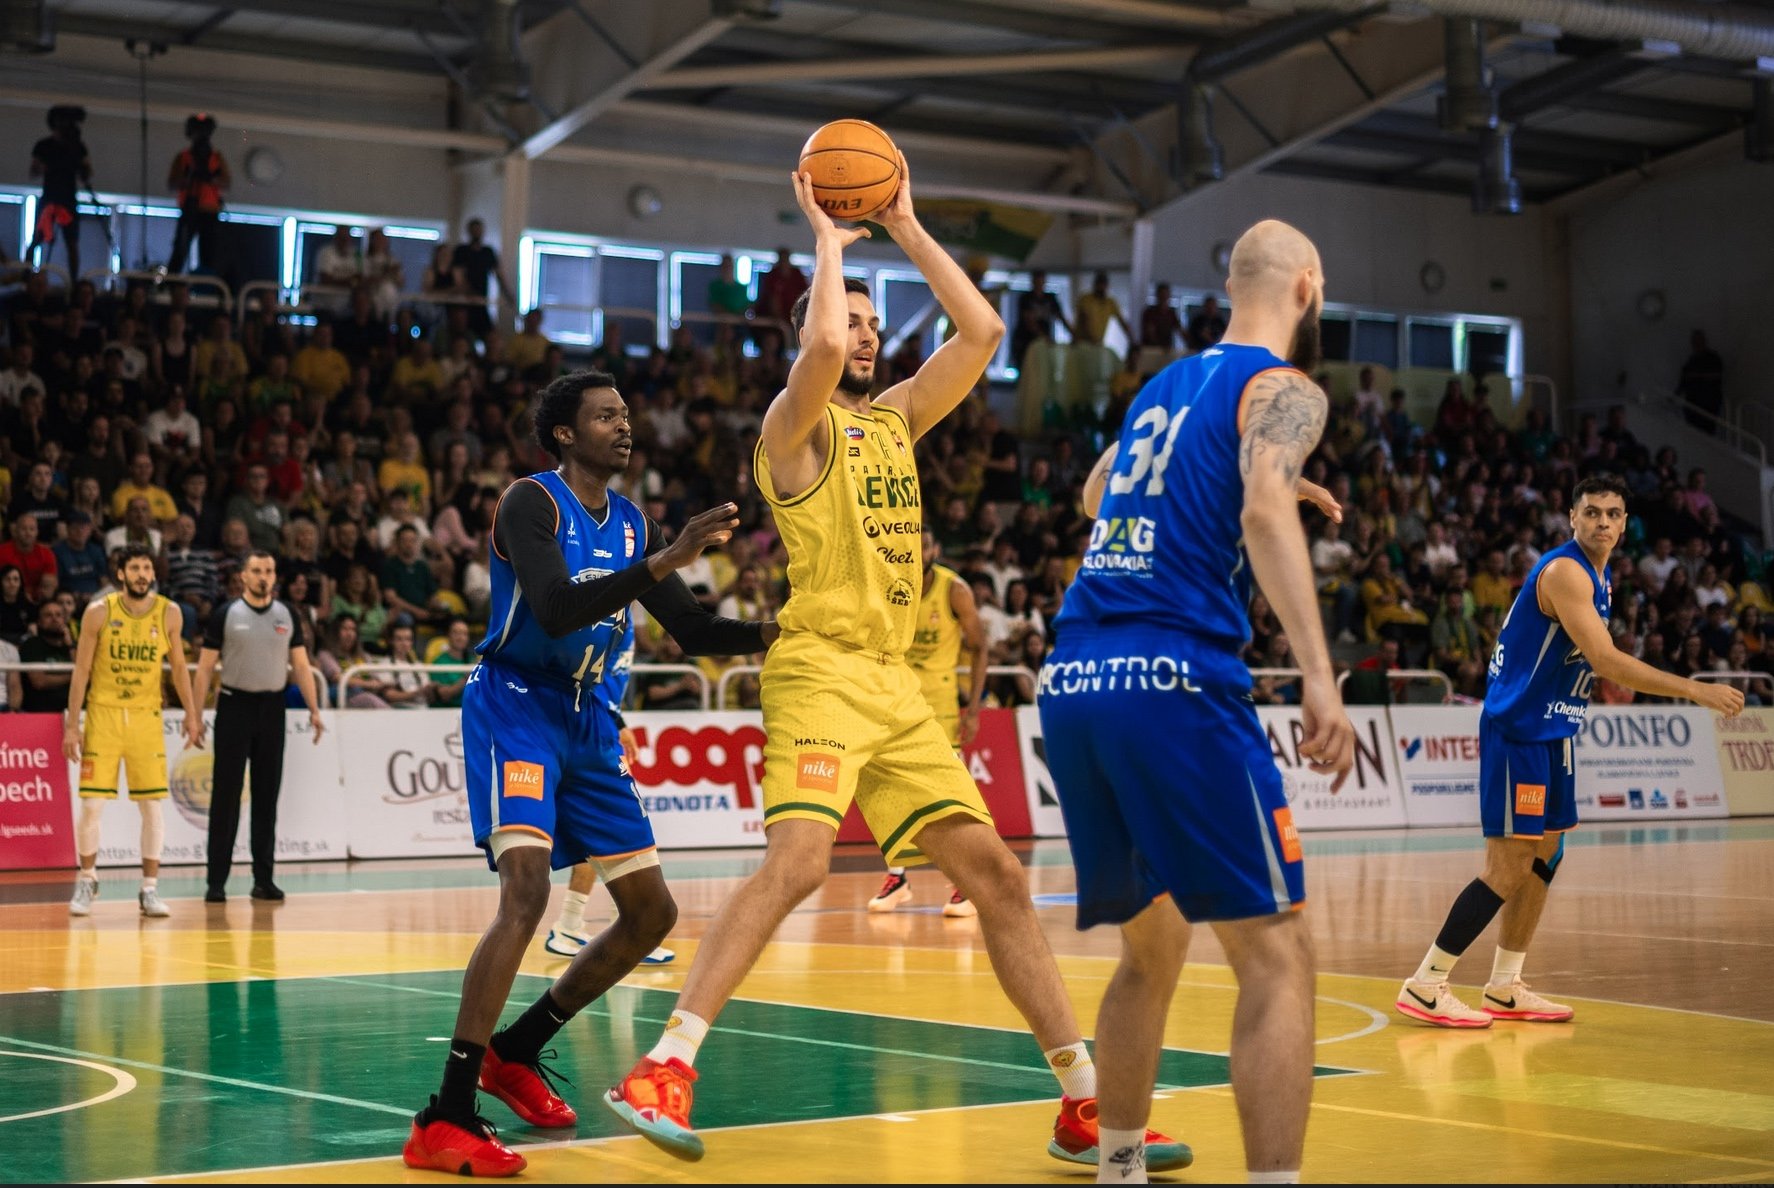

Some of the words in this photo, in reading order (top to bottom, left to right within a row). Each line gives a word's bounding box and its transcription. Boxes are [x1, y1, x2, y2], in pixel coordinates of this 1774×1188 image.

[1110, 405, 1191, 496] 31
[110, 644, 158, 662] LEVICE
[572, 644, 605, 683] 14
[1554, 701, 1586, 717] Chemk
[794, 738, 846, 751] HALEON
[509, 768, 540, 785] niké
[802, 760, 836, 778] niké
[644, 795, 729, 812] EDNOTA
